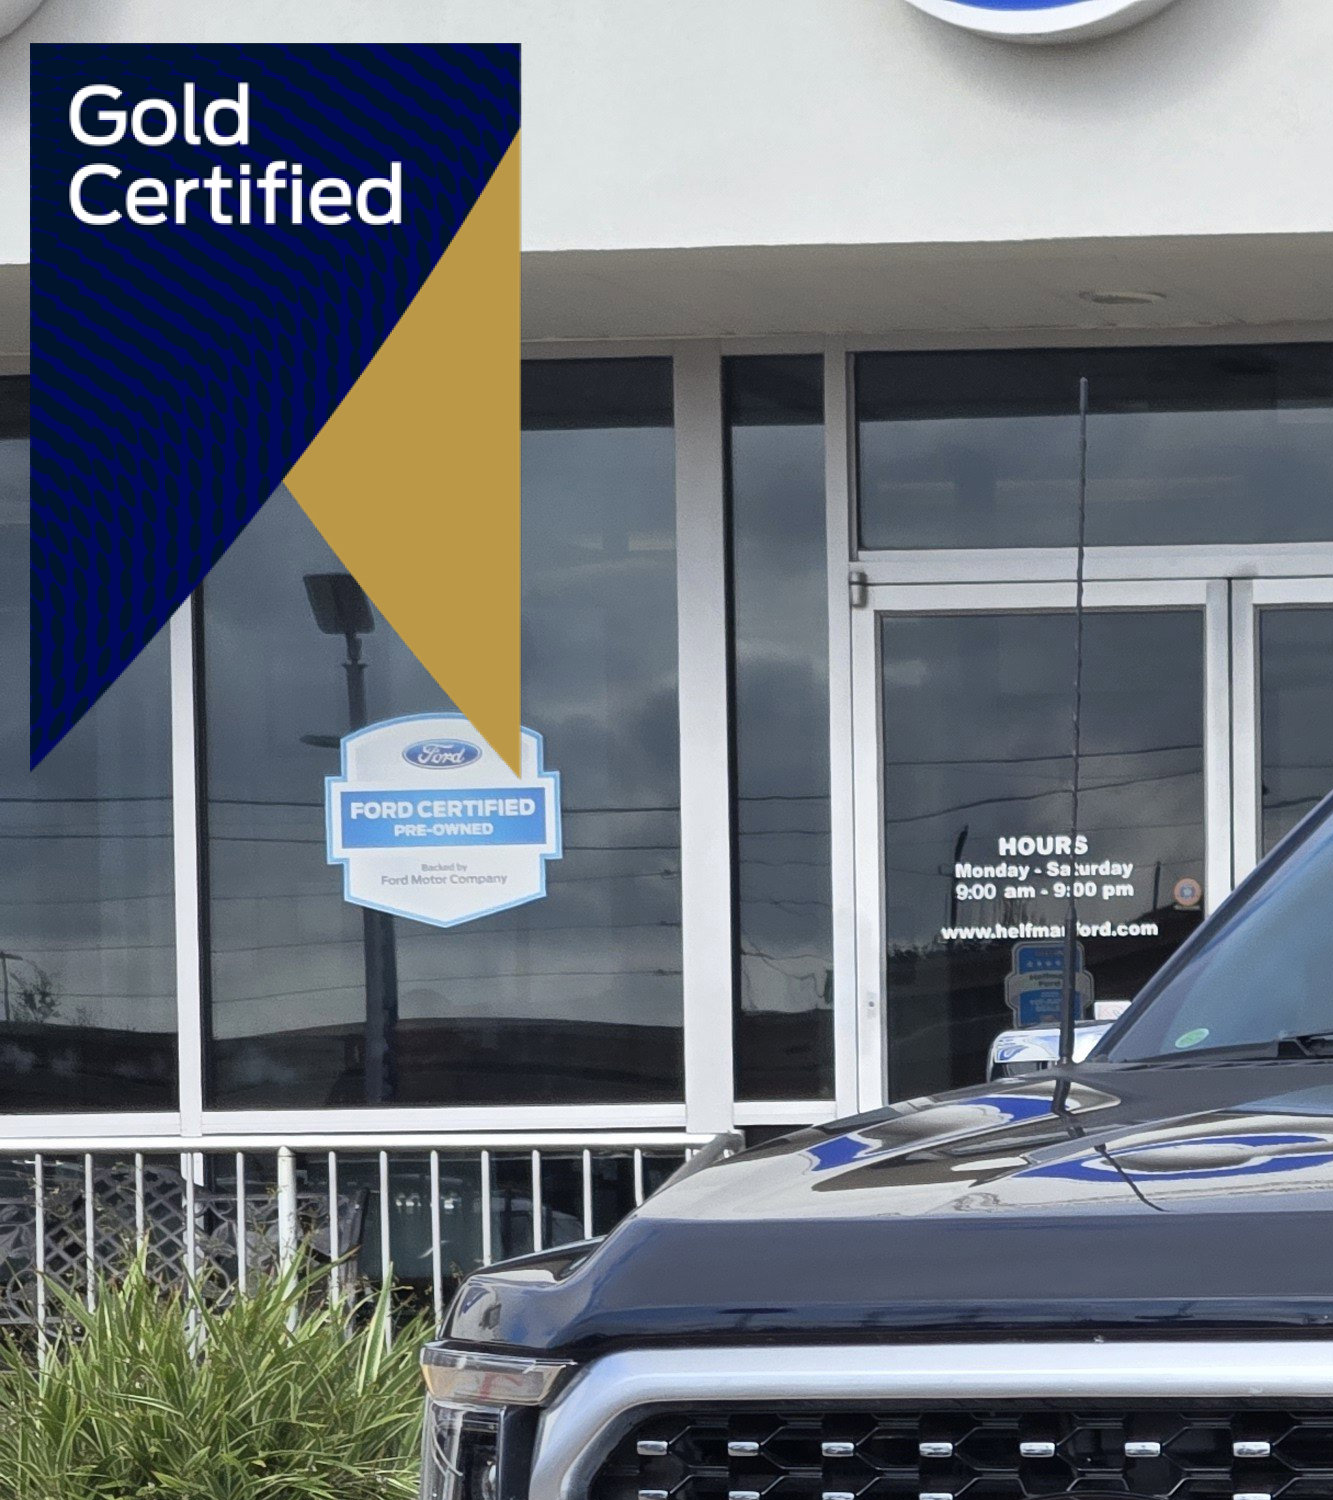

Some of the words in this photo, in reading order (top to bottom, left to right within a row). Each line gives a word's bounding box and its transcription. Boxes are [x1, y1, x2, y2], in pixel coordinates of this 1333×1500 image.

[417, 743, 466, 764] Ford
[351, 801, 413, 819] FORD
[417, 798, 536, 817] CERTIFIED
[394, 823, 494, 837] PRE-OWNED
[998, 835, 1089, 856] HOURS
[381, 874, 409, 886] Ford
[411, 874, 448, 885] Motor
[449, 873, 508, 885] Company
[955, 861, 1030, 881] Monday
[955, 882, 997, 901] 9:00
[1004, 885, 1036, 899] am
[1053, 881, 1097, 898] 9:00
[1102, 883, 1134, 900] pm
[941, 919, 1158, 940] www.helfmaord.com
